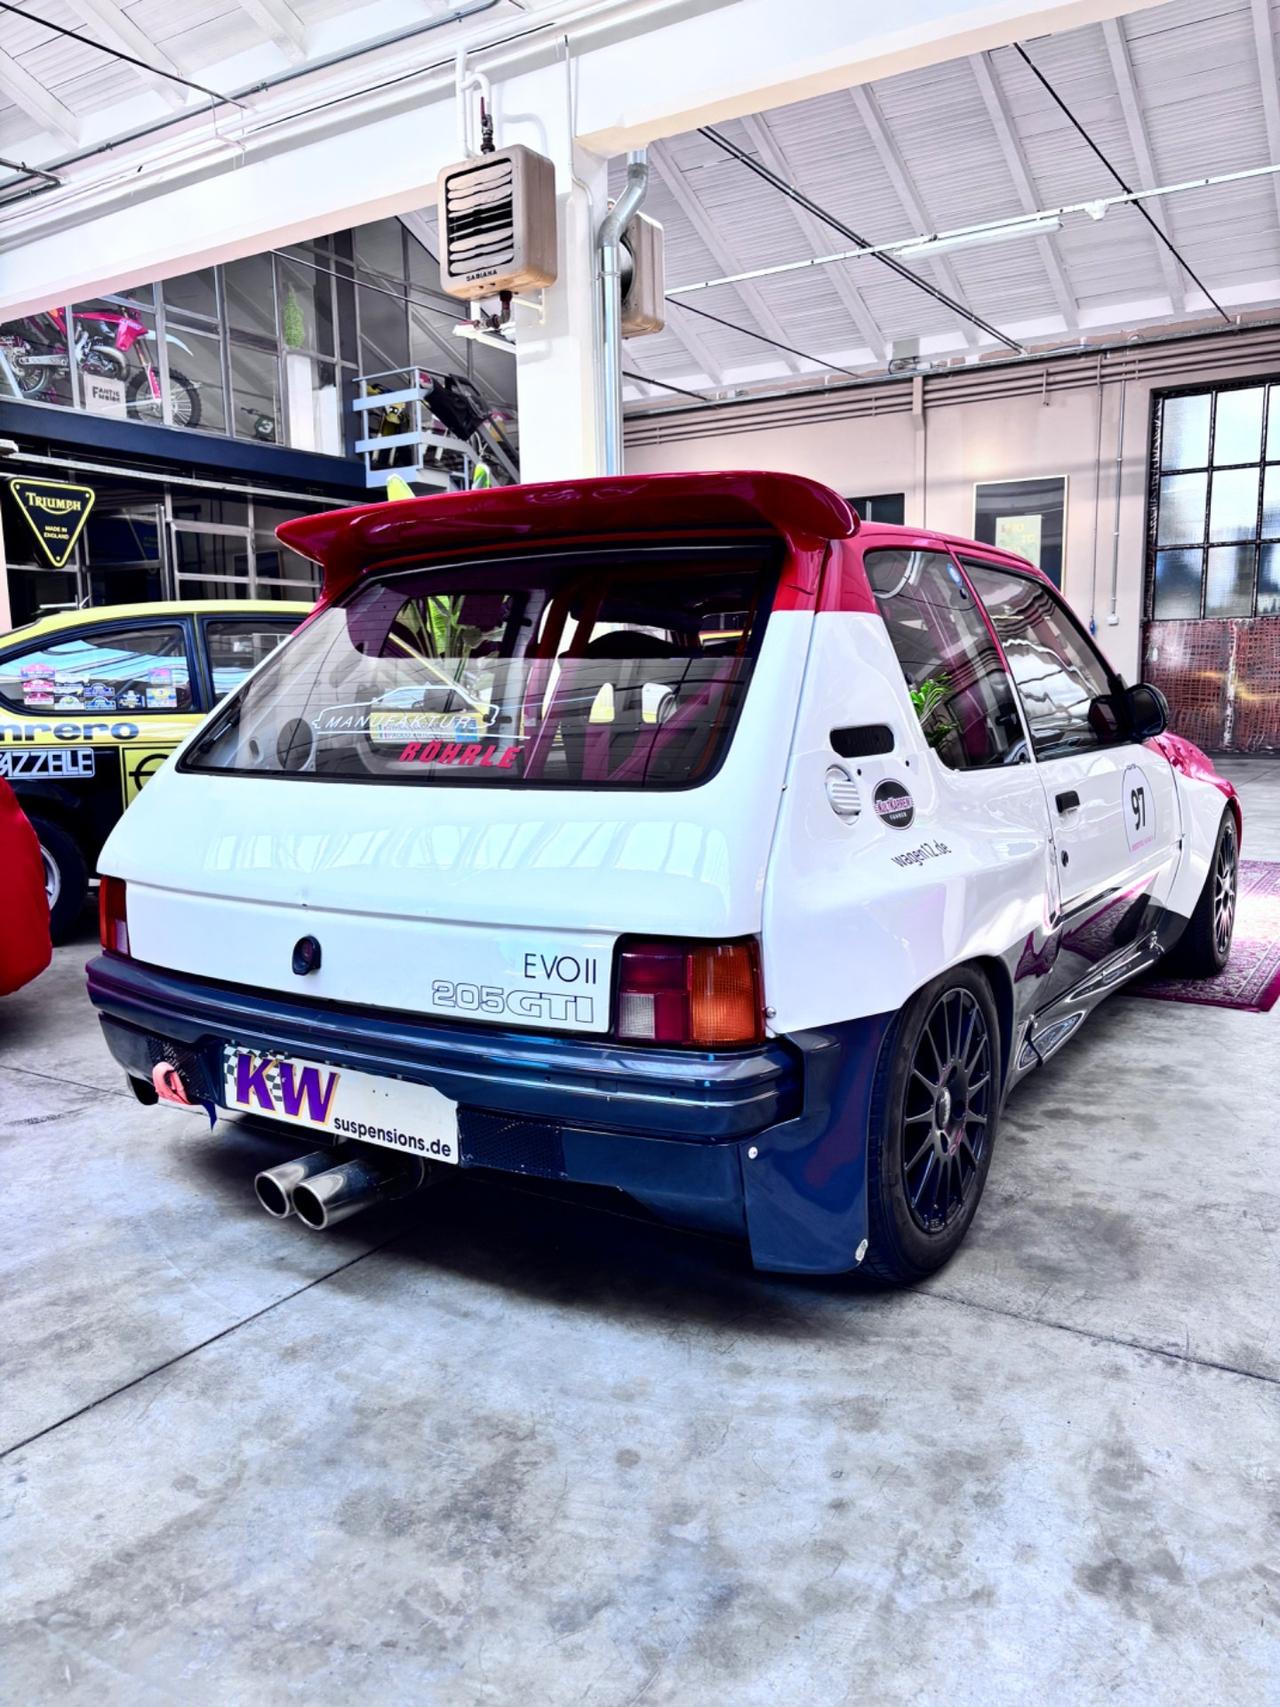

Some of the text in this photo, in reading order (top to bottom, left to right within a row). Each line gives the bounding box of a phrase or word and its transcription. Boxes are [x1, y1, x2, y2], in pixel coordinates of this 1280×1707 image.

[25, 491, 82, 511] TRIUMPH
[43, 532, 70, 540] ENGLAND
[325, 715, 471, 730] MANUFAKTUR
[0, 750, 93, 777] AZZELLE
[400, 739, 523, 769] RÖHRLE
[1131, 786, 1146, 831] 97
[891, 839, 952, 867] wagen12.de
[236, 1053, 340, 1126] KW
[333, 1116, 452, 1157] suspensions.de
